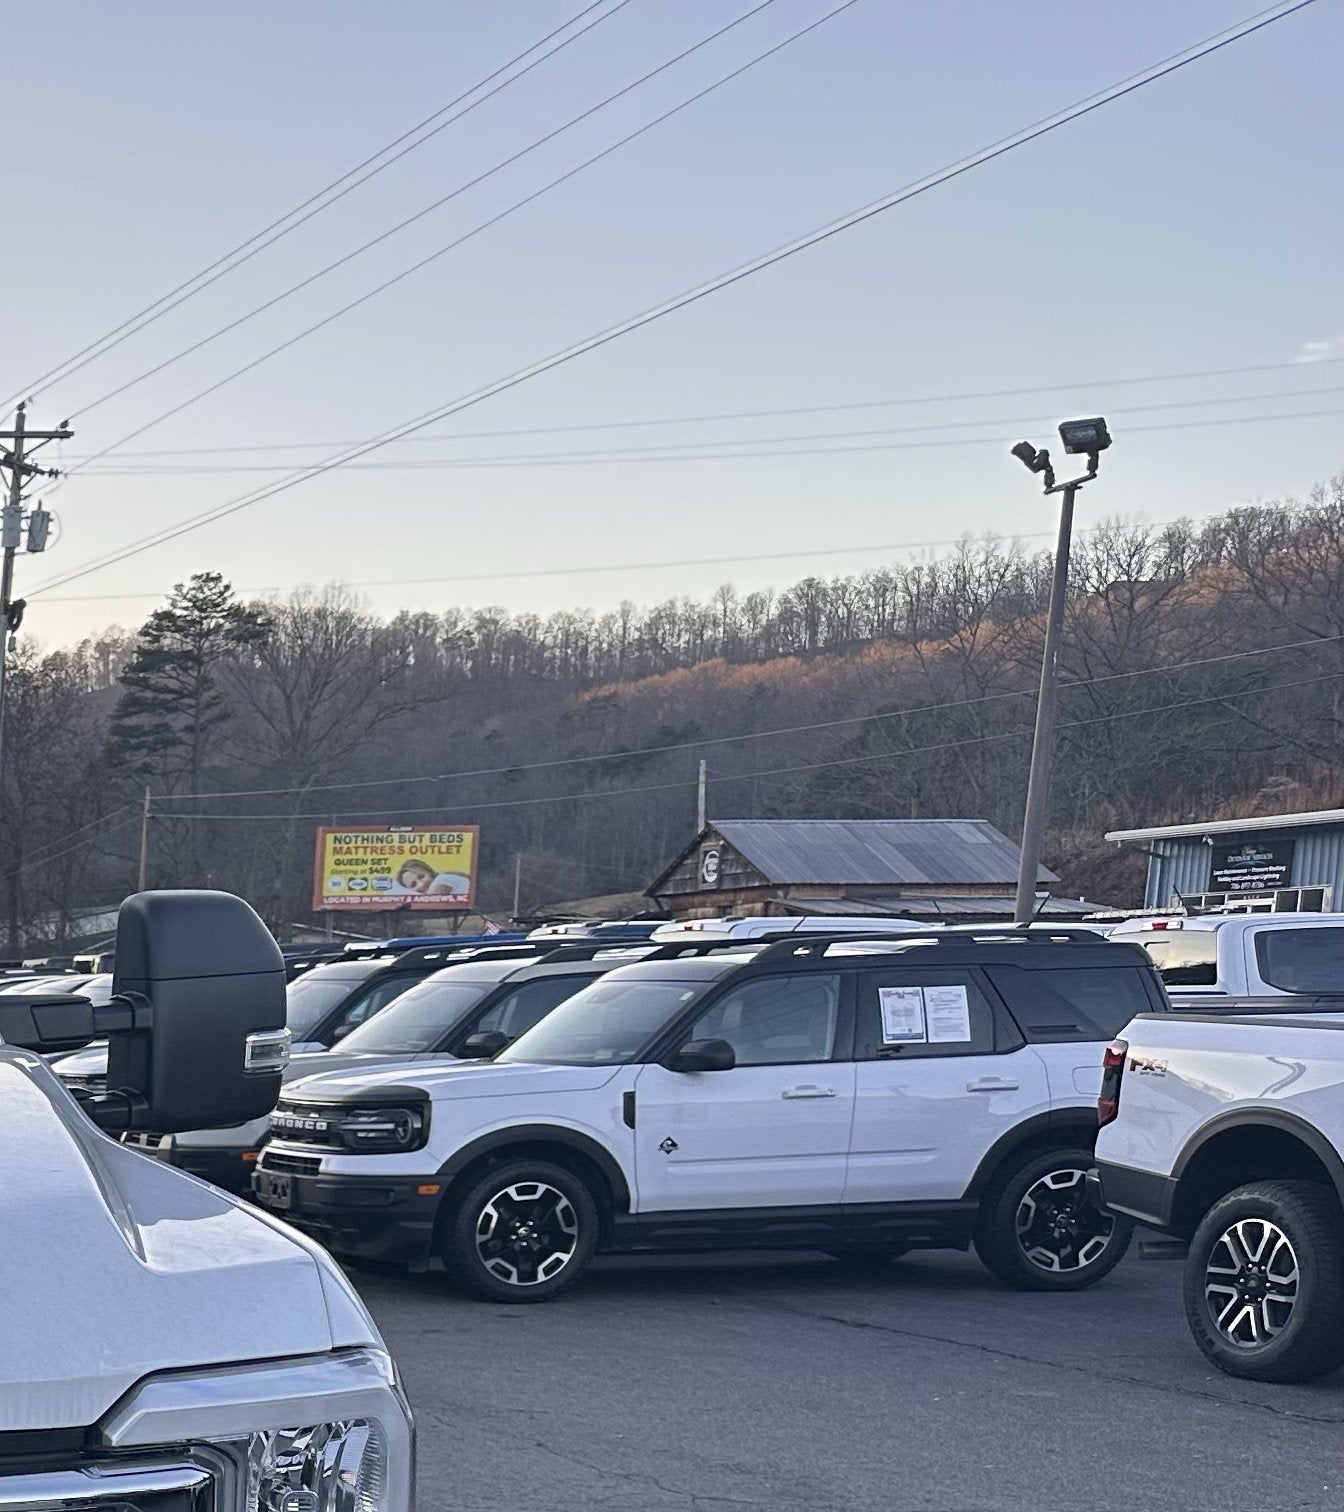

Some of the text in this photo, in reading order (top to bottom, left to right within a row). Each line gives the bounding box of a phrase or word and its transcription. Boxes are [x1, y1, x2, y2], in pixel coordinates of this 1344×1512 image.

[333, 833, 464, 845] NOTHING BUT BEDS
[332, 844, 463, 856] MATTRESS OUTLET
[334, 857, 389, 866] QUEEN SET
[323, 896, 361, 904] LOCATED
[362, 896, 371, 904] IN
[1130, 1058, 1168, 1072] FX4
